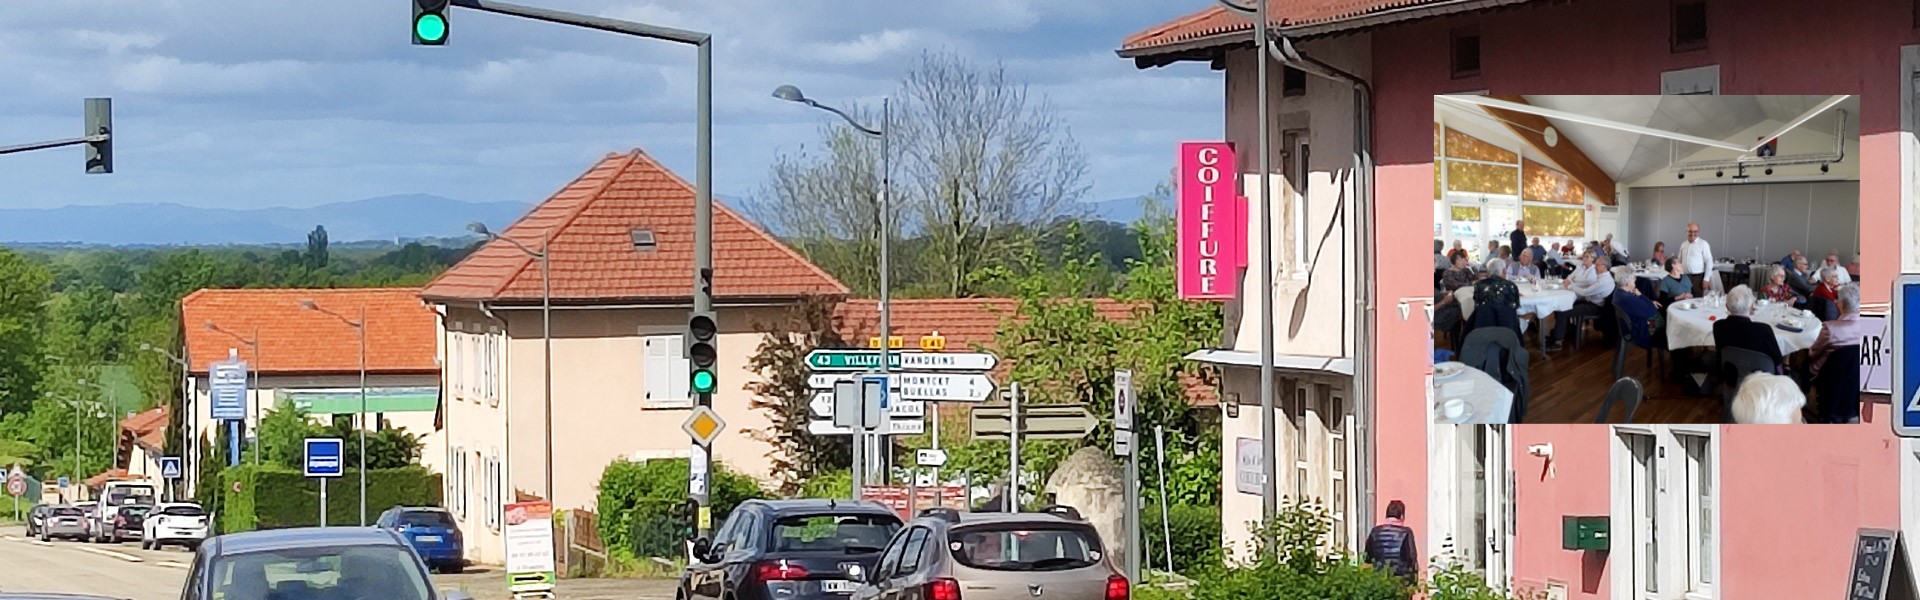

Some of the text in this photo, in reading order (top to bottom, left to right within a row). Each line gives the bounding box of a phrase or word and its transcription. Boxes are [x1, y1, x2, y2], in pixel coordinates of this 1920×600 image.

[1198, 147, 1220, 294] COIFFURE
[817, 355, 831, 366] 43
[904, 356, 988, 365] VANDEINS 7
[904, 377, 949, 386] MONTCET
[969, 377, 974, 385] 4
[904, 387, 947, 397] BUELLAS
